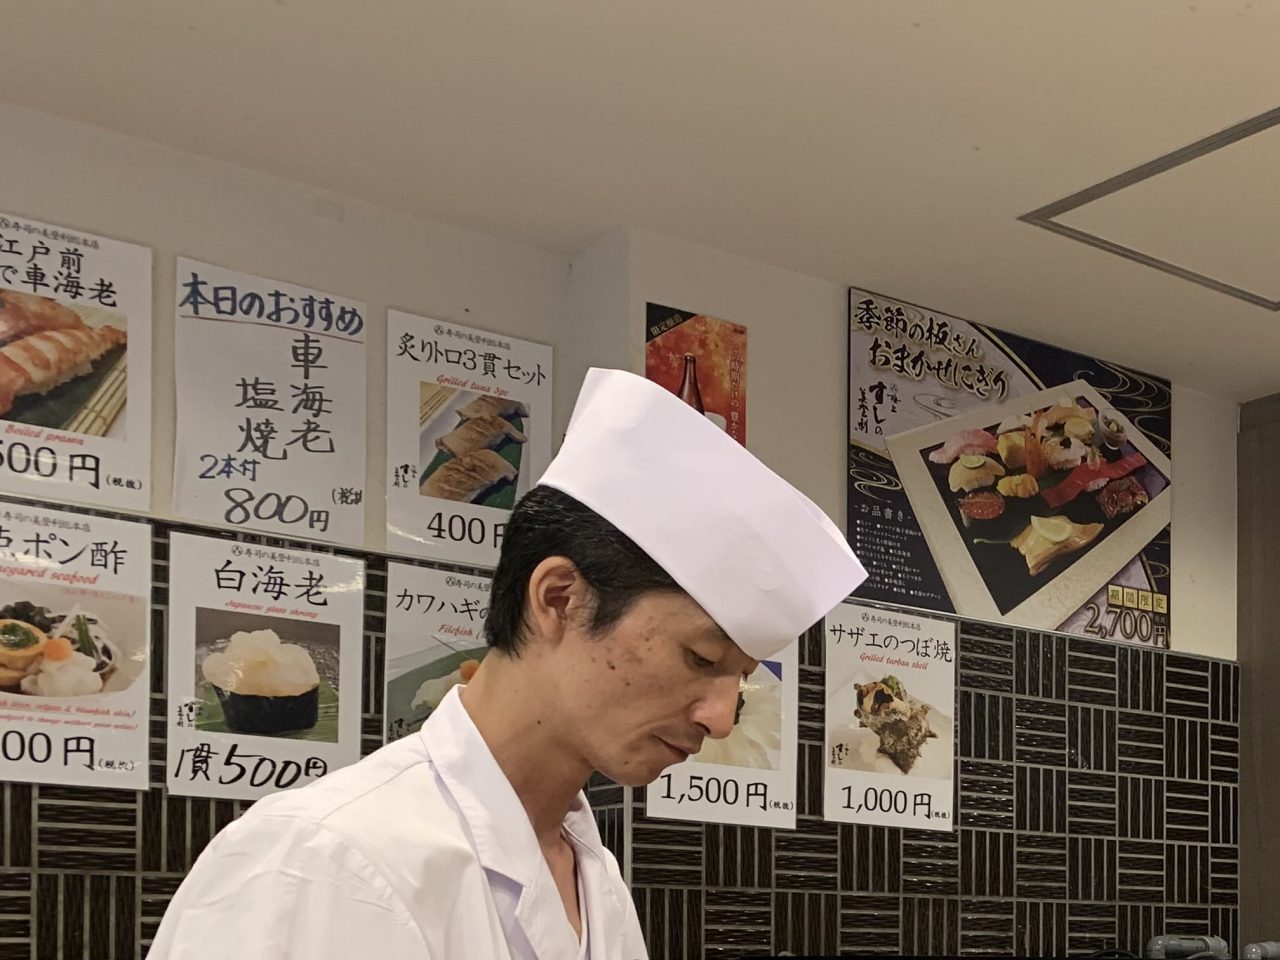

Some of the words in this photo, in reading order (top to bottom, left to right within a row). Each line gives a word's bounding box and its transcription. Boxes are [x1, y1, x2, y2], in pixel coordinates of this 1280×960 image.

[178, 272, 364, 336] 本日のおすすめ
[854, 298, 982, 359] 季節の板さん
[396, 331, 547, 387] 炙りトロ3貫セット
[436, 374, 468, 388] Grilled
[869, 336, 1006, 399] おまかせにぎり
[285, 333, 335, 453] 車海老
[0, 440, 100, 490] 00円
[223, 487, 330, 532] 800円
[50, 571, 100, 585] seafood
[214, 560, 329, 606] 白海老
[1110, 588, 1165, 609] 期間限定
[438, 624, 474, 638] Filefish
[829, 623, 953, 663] サザエのつぼ焼
[1083, 602, 1168, 647] 2,700円
[860, 652, 884, 662] Grilled
[660, 772, 769, 812] 1,500円
[841, 785, 933, 820] 1,000円
